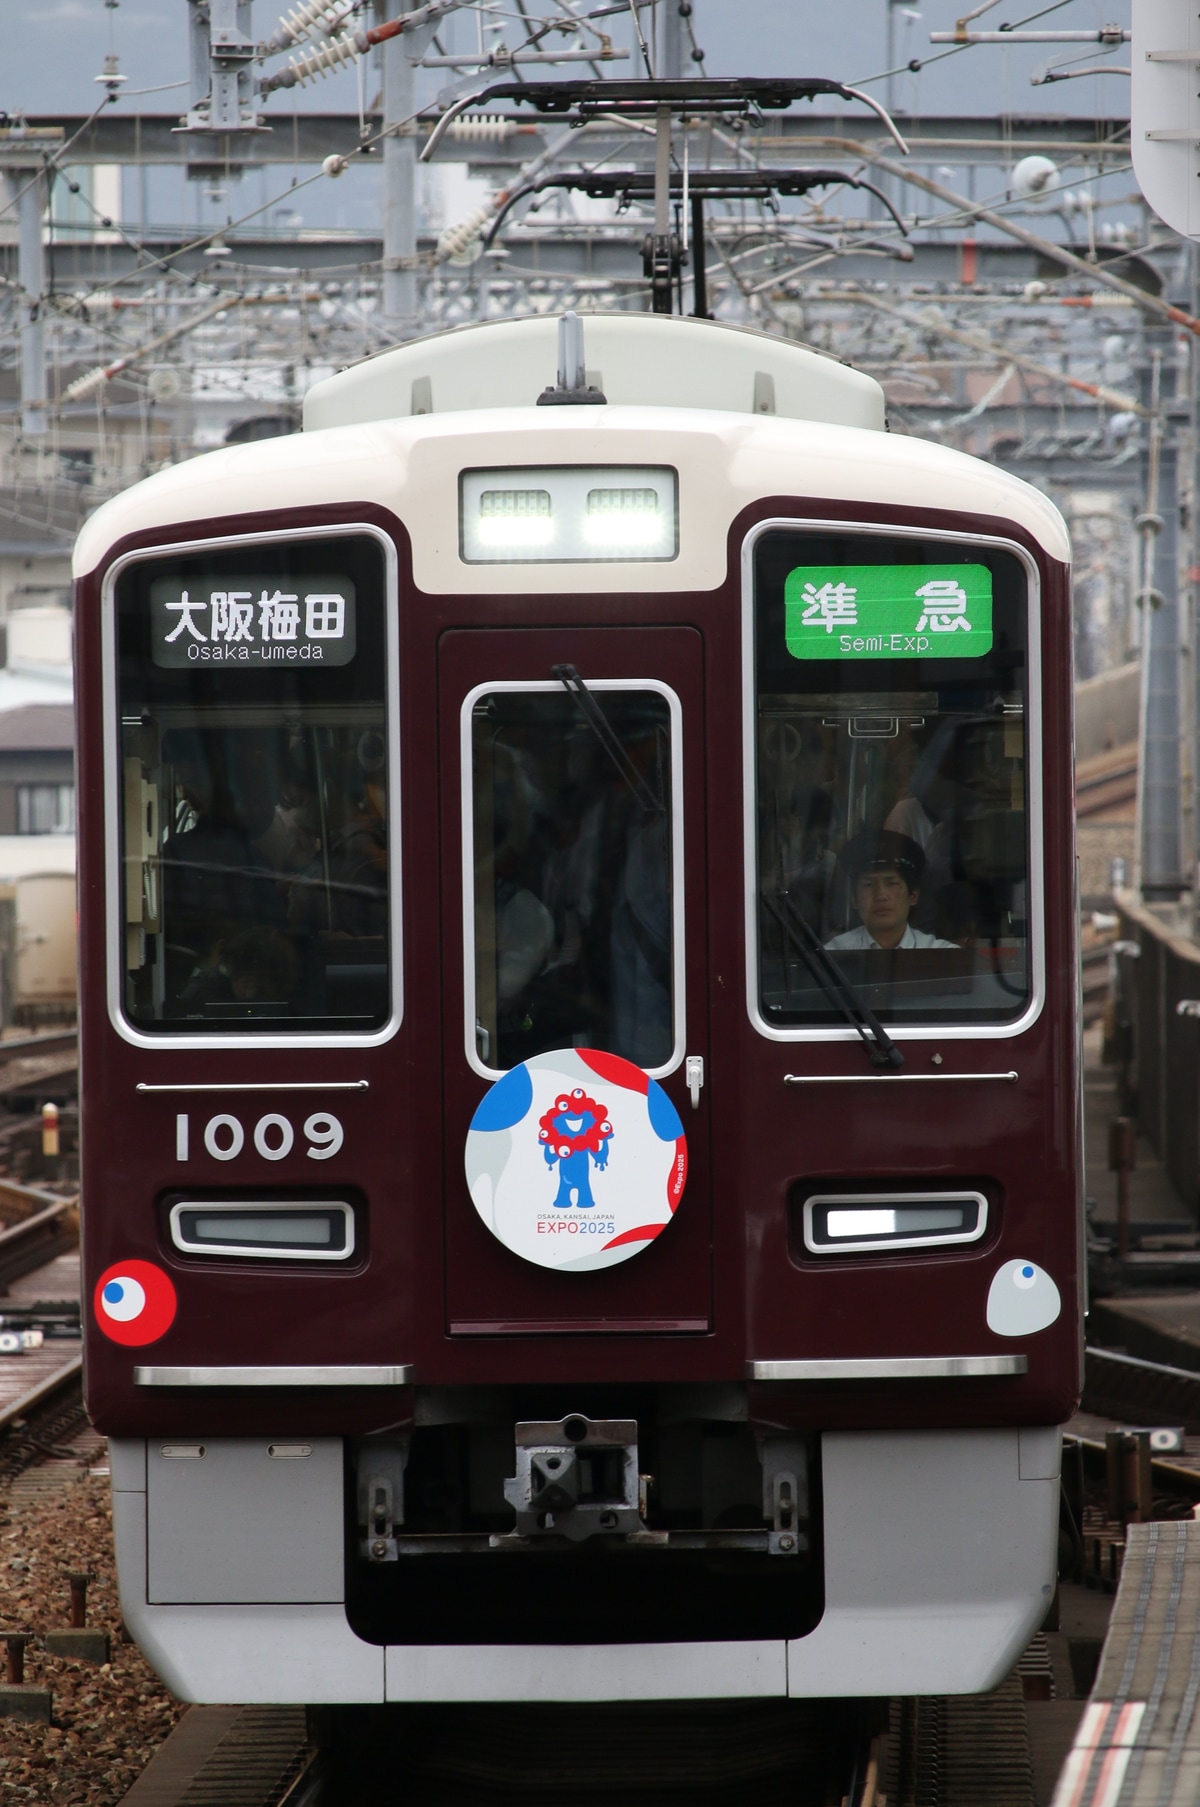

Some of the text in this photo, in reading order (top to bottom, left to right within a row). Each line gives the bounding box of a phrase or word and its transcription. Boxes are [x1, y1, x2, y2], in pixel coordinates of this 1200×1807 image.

[164, 590, 346, 642] 大阪梅田
[187, 643, 324, 661] Osaka-umeda
[839, 634, 934, 653] Semi-Exp.
[176, 1112, 344, 1161] 1009
[592, 1213, 615, 1221] JAPAN
[536, 1221, 615, 1234] EXPO2025
